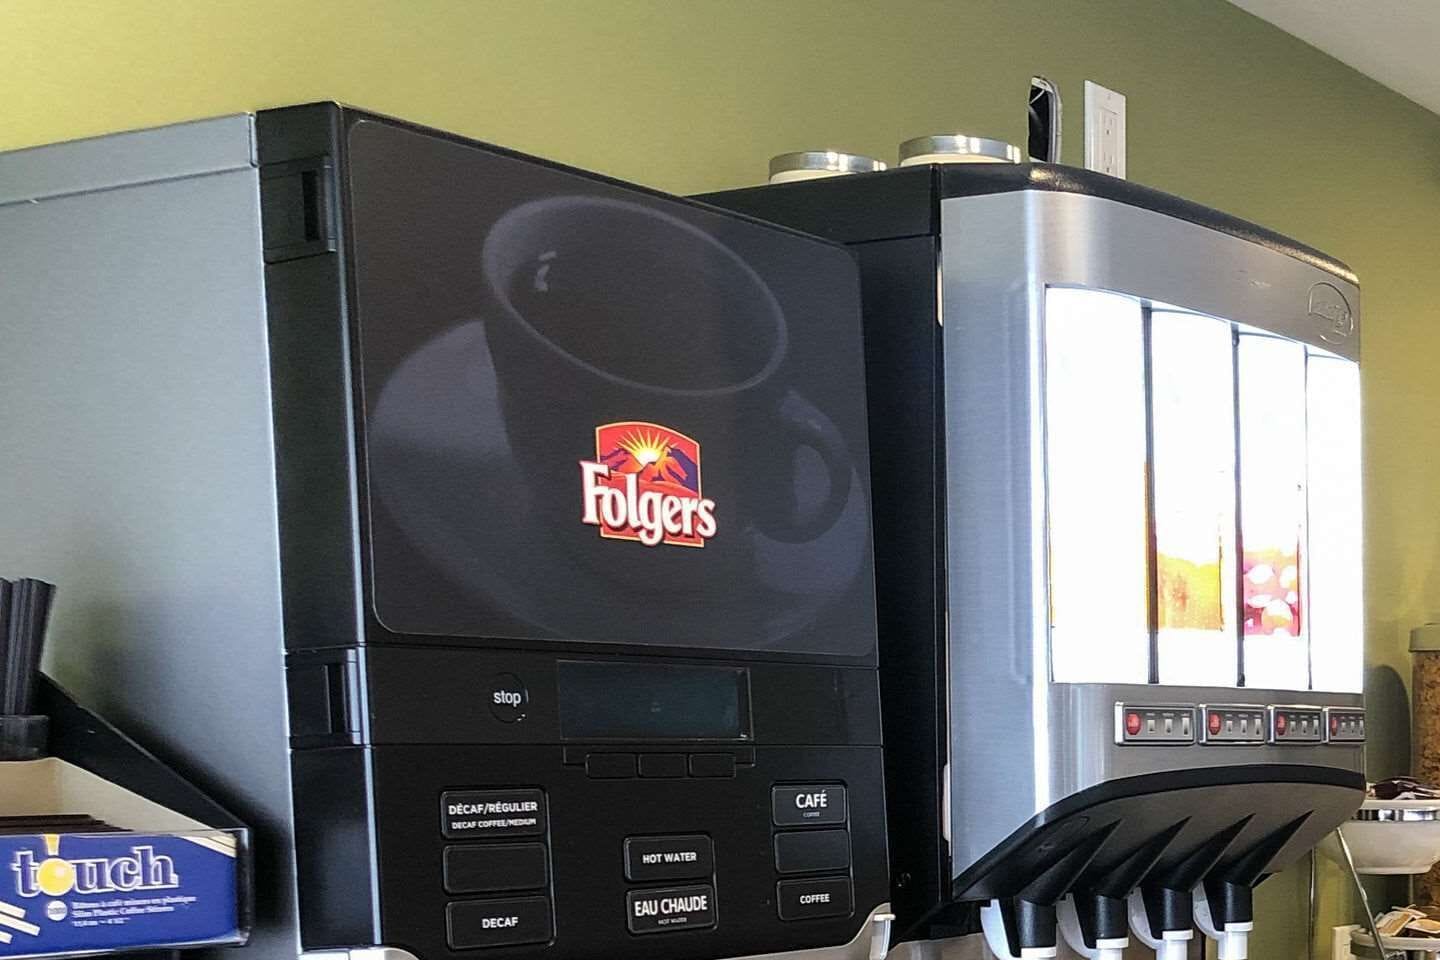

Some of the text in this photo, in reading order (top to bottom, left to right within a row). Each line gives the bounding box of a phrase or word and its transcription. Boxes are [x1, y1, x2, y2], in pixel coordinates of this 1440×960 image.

[578, 459, 718, 547] Folgers
[493, 688, 522, 707] stop
[795, 789, 828, 809] CAFÉ
[451, 820, 477, 830] DECAF
[642, 851, 697, 864] HOT WATER
[634, 895, 708, 916] EAU CHAUDE
[799, 893, 831, 905] COFFEE
[481, 916, 519, 929] DECAF
